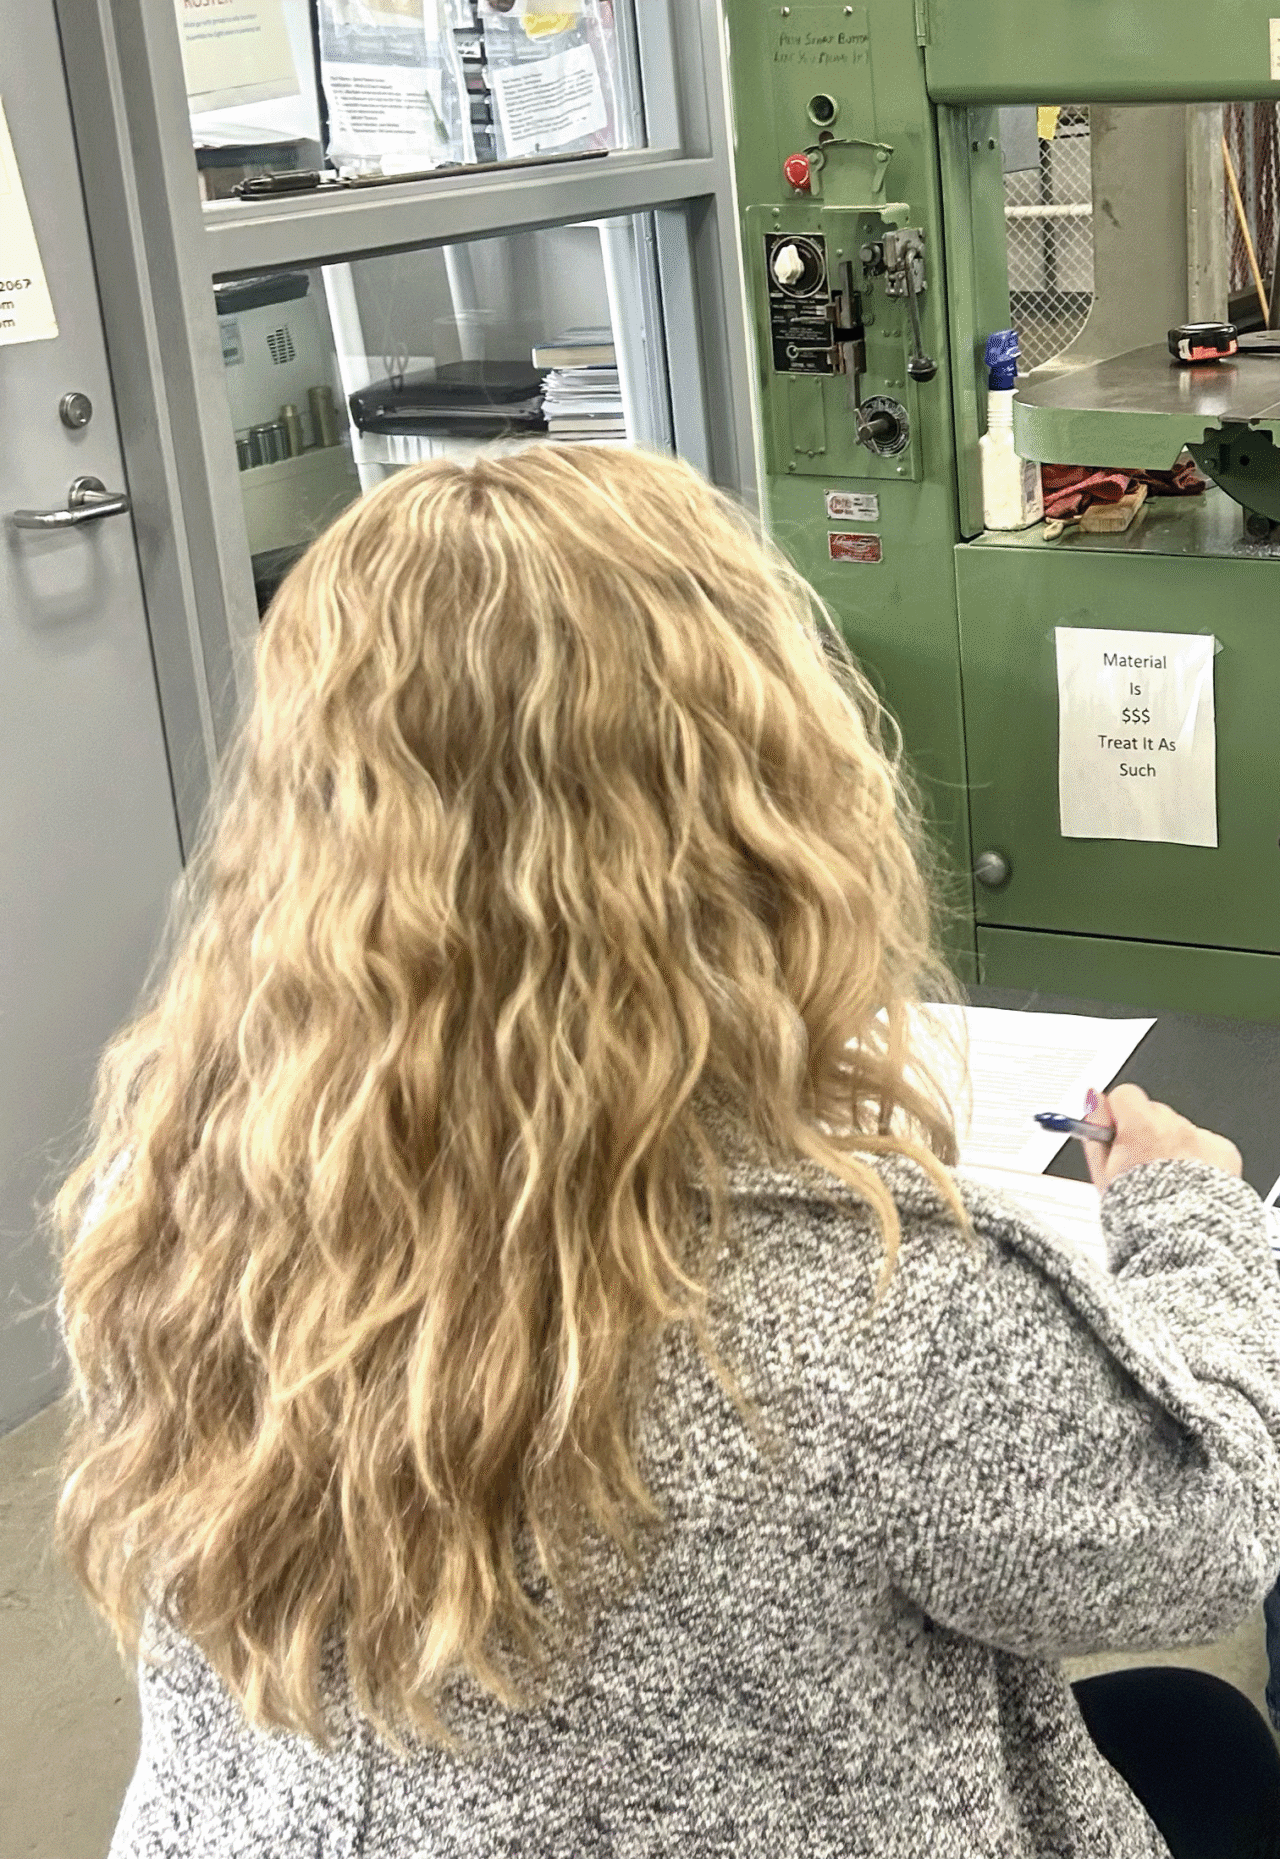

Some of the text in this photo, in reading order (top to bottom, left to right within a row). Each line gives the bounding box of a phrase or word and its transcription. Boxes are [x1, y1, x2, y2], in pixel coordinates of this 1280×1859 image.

[184, 0, 233, 8] ROST
[1103, 653, 1167, 669] Material
[1129, 682, 1142, 696] Is
[1121, 707, 1151, 725] $$$
[1098, 734, 1177, 752] Treat It As
[1119, 763, 1157, 777] Such
